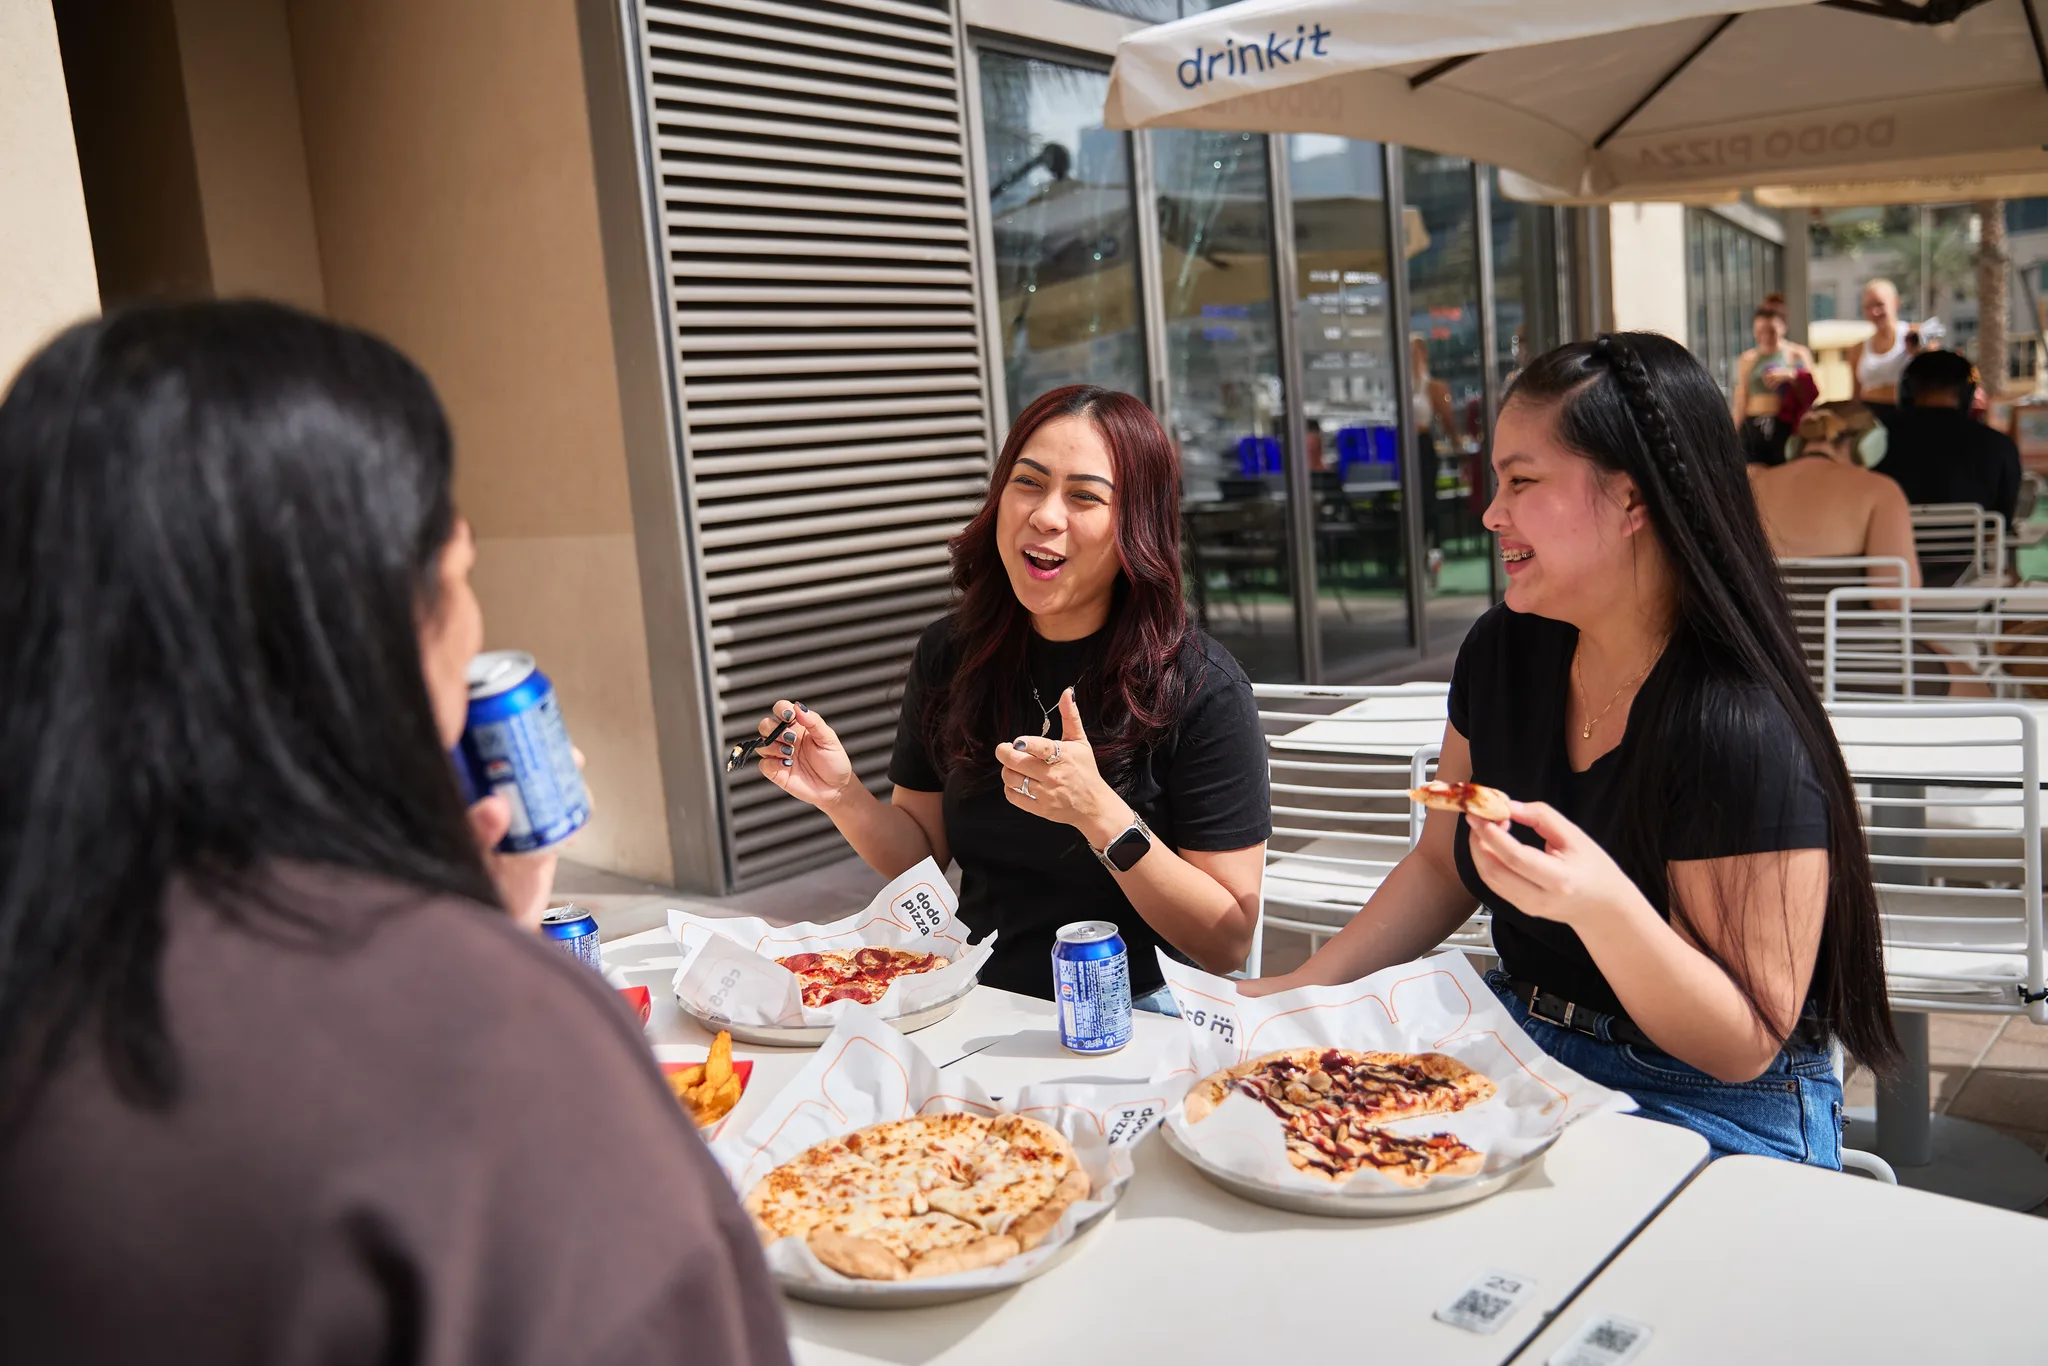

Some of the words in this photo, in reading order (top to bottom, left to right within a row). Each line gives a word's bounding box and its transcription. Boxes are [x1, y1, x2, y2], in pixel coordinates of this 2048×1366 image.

[1177, 23, 1331, 89] drinkit
[901, 899, 930, 936] pizza
[916, 892, 941, 925] dodo
[1107, 1110, 1136, 1146] pizza
[1484, 1275, 1523, 1294] 23
